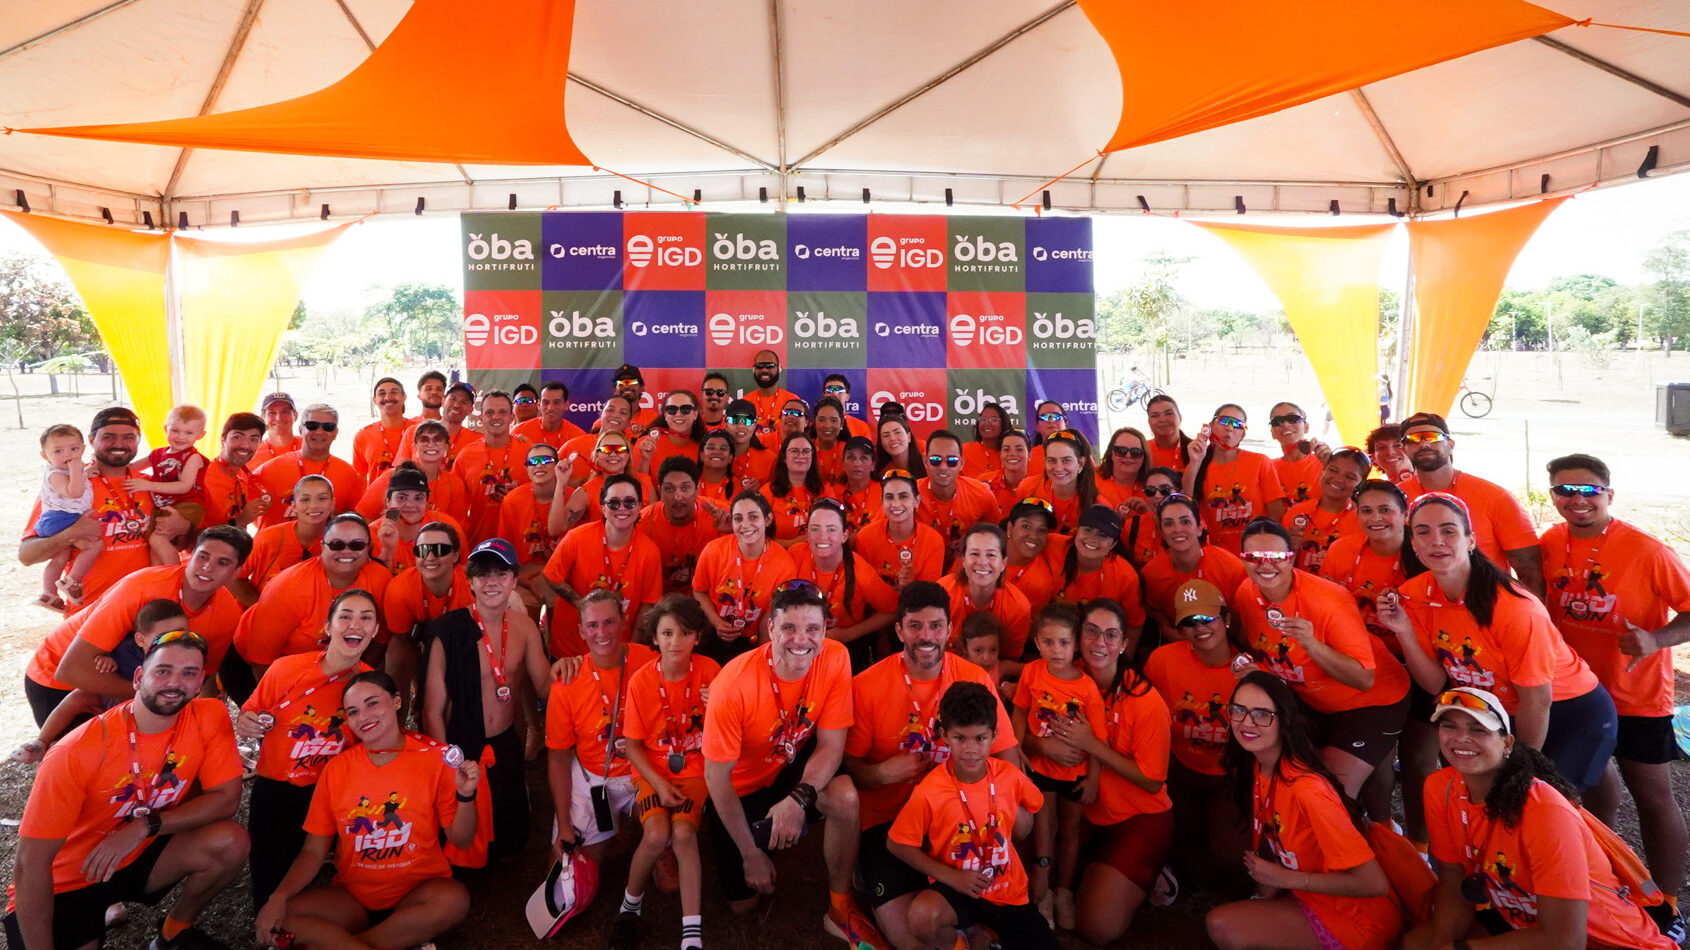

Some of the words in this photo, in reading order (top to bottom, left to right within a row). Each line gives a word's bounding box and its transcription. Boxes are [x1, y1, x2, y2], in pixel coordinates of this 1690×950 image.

[657, 235, 683, 243] grupo
[900, 237, 925, 245] grupo
[570, 244, 616, 256] centra
[814, 245, 860, 257] centra
[657, 247, 702, 267] IGD
[900, 248, 943, 268] IGD
[493, 314, 519, 322] grupo
[739, 314, 764, 322] grupo
[651, 322, 698, 334] centra
[894, 323, 940, 335] centra
[494, 325, 538, 345] IGD
[739, 325, 784, 345] IGD
[979, 326, 1023, 345] IGD
[899, 391, 925, 399] grupo
[569, 400, 605, 413] cent
[901, 402, 944, 422] GD
[1061, 400, 1097, 412] entra
[955, 418, 1020, 426] HORTI
[290, 737, 347, 759] IGD
[354, 822, 412, 853] IGD
[360, 844, 406, 862] RUN
